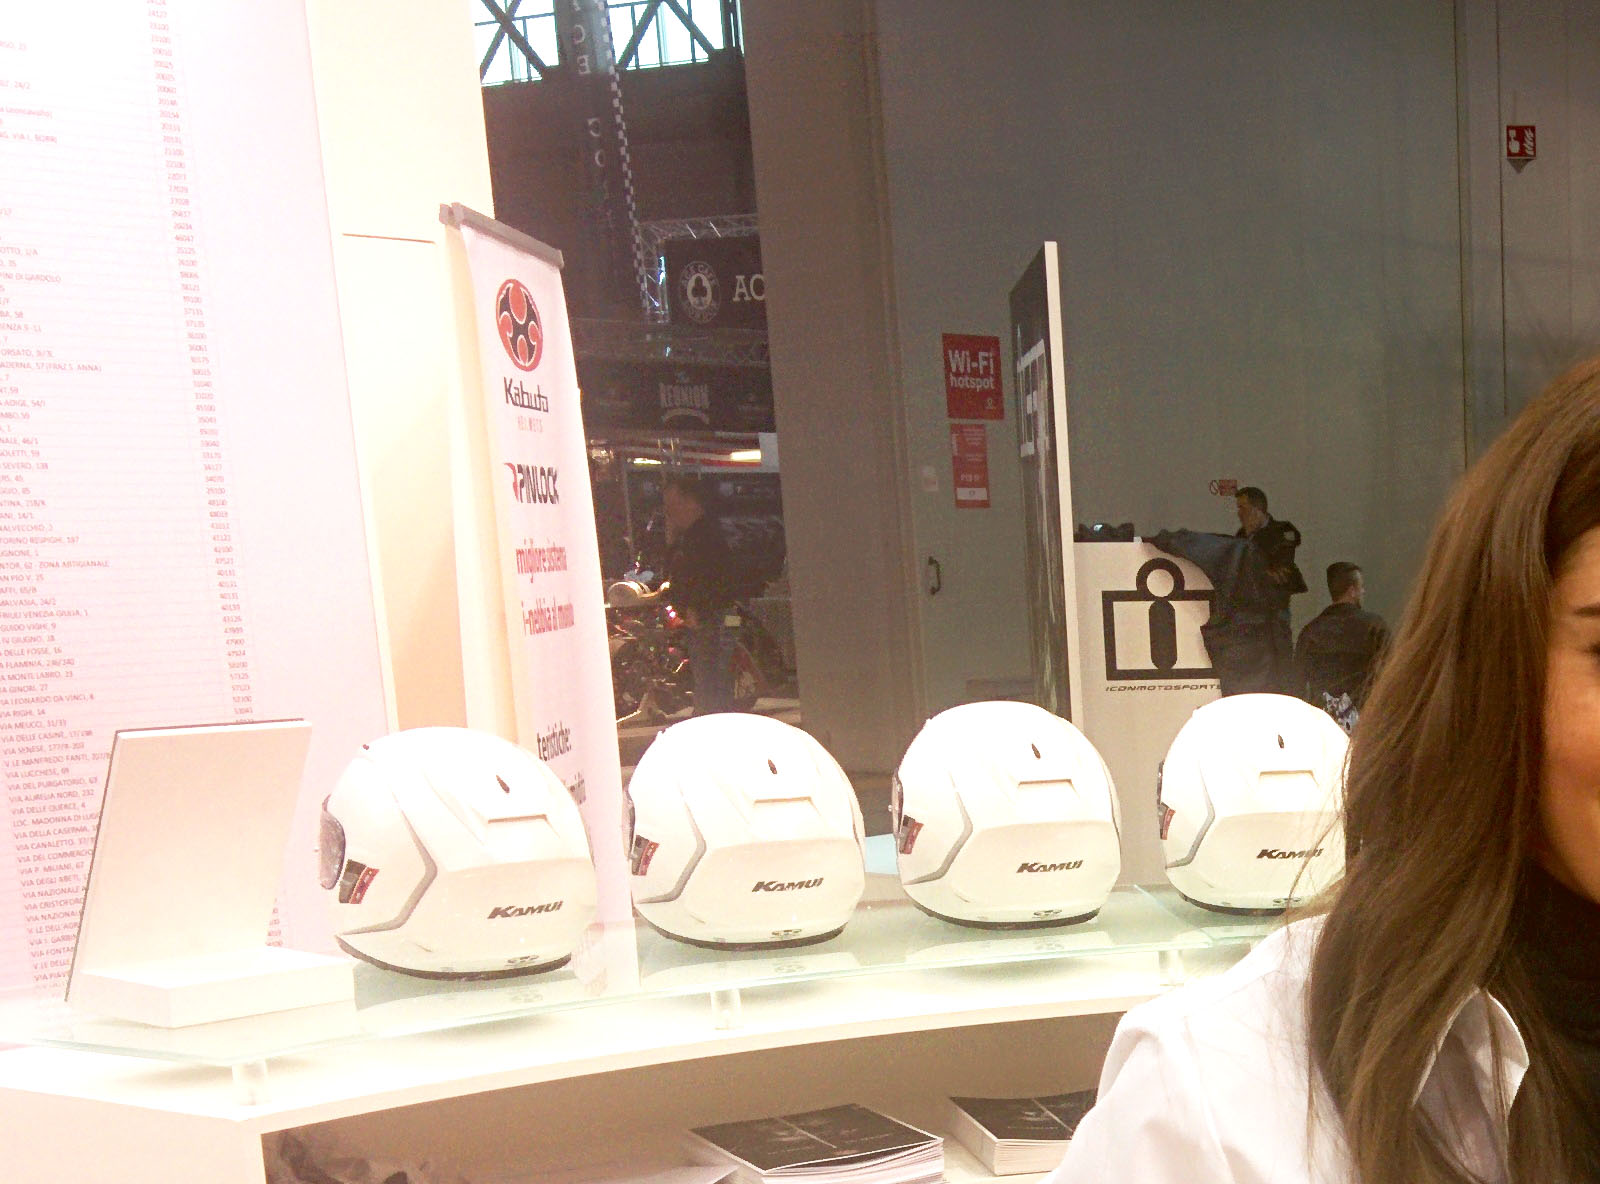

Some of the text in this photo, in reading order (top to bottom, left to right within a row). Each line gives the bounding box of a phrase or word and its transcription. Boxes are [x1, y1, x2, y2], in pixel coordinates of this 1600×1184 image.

[948, 349, 995, 375] Wi-Fi
[949, 375, 996, 393] hotspot
[503, 376, 549, 413] Kabuto
[31, 815, 73, 826] MADONNA
[1256, 847, 1324, 860] KAMUI
[1016, 859, 1084, 874] KAMUI
[751, 877, 825, 893] KAMUI
[487, 900, 564, 920] KAMUI
